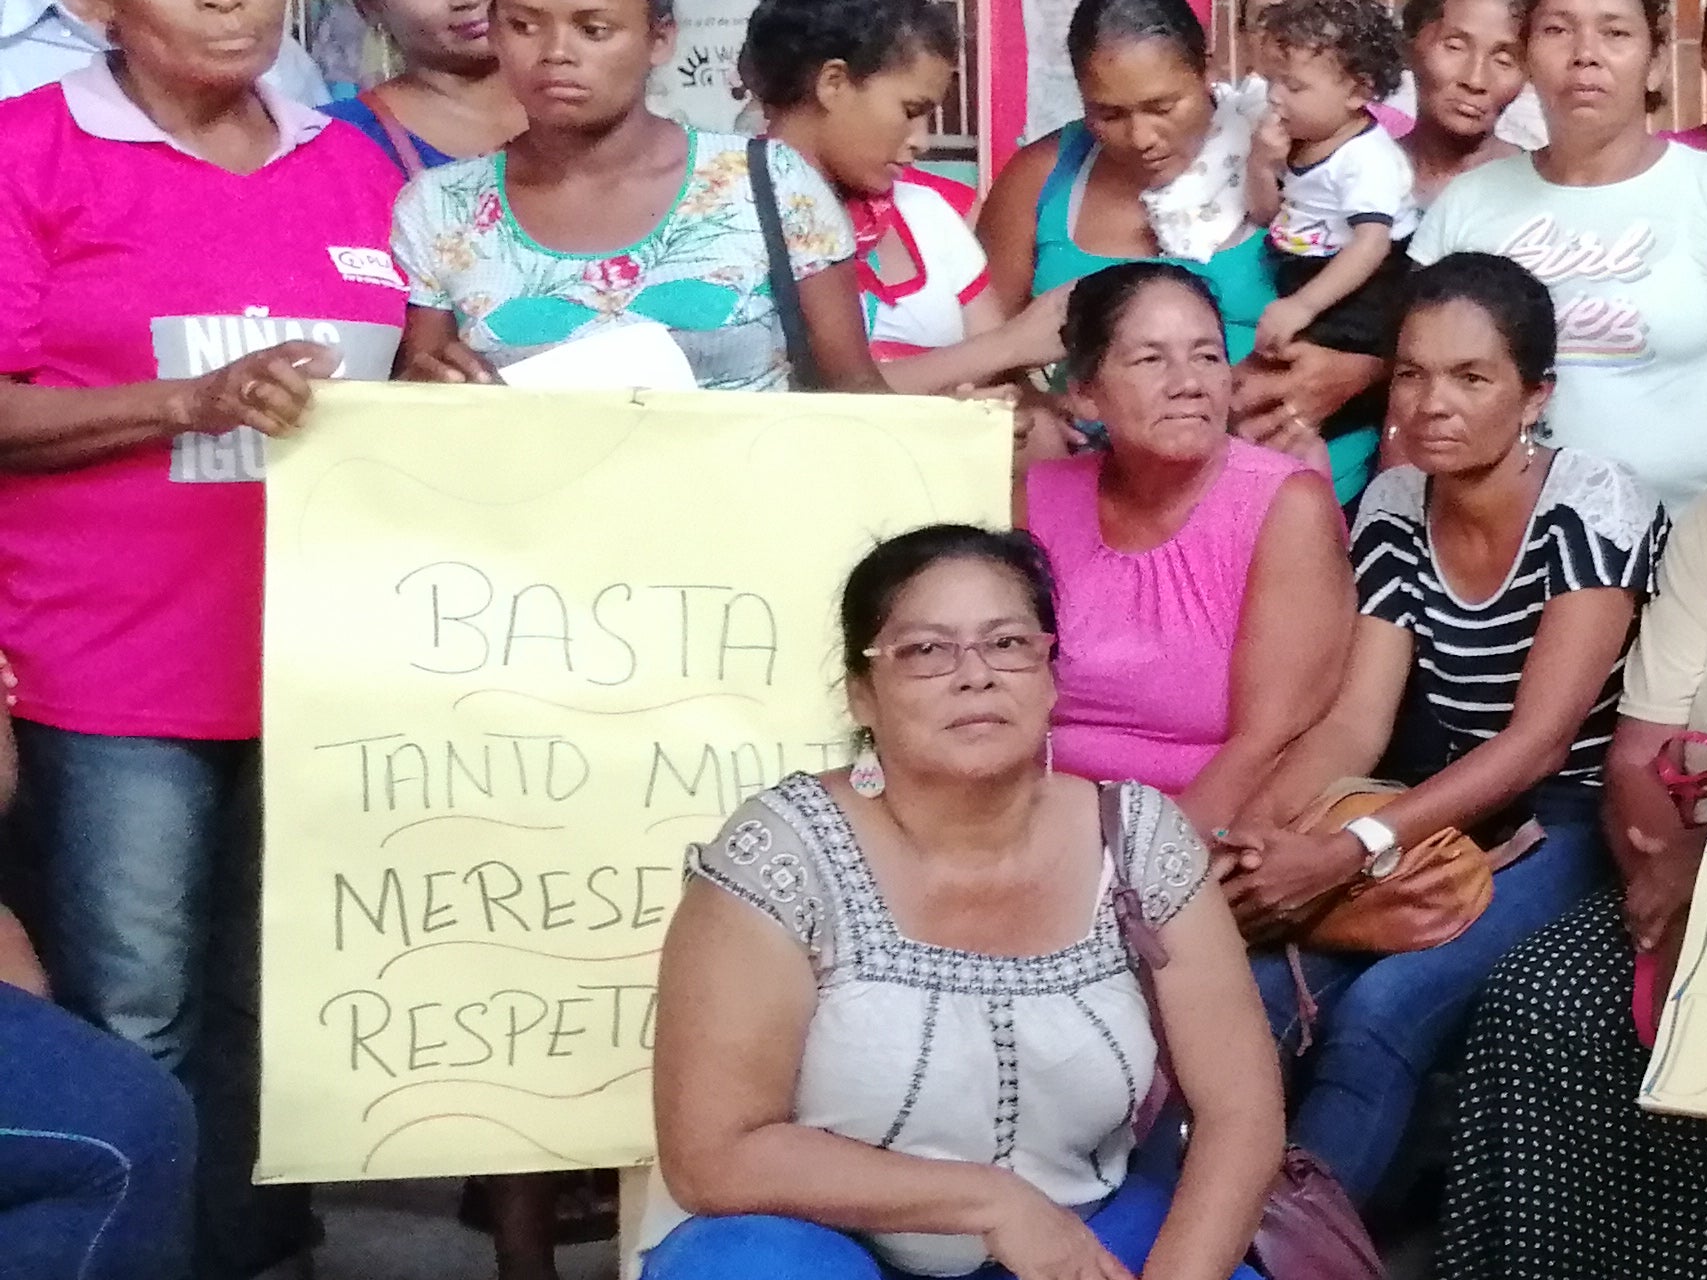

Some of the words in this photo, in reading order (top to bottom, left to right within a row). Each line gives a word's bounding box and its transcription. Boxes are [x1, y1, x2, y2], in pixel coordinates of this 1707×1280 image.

[395, 561, 777, 686] BASTA
[314, 732, 591, 812] TANTO
[335, 860, 673, 951] MERESE
